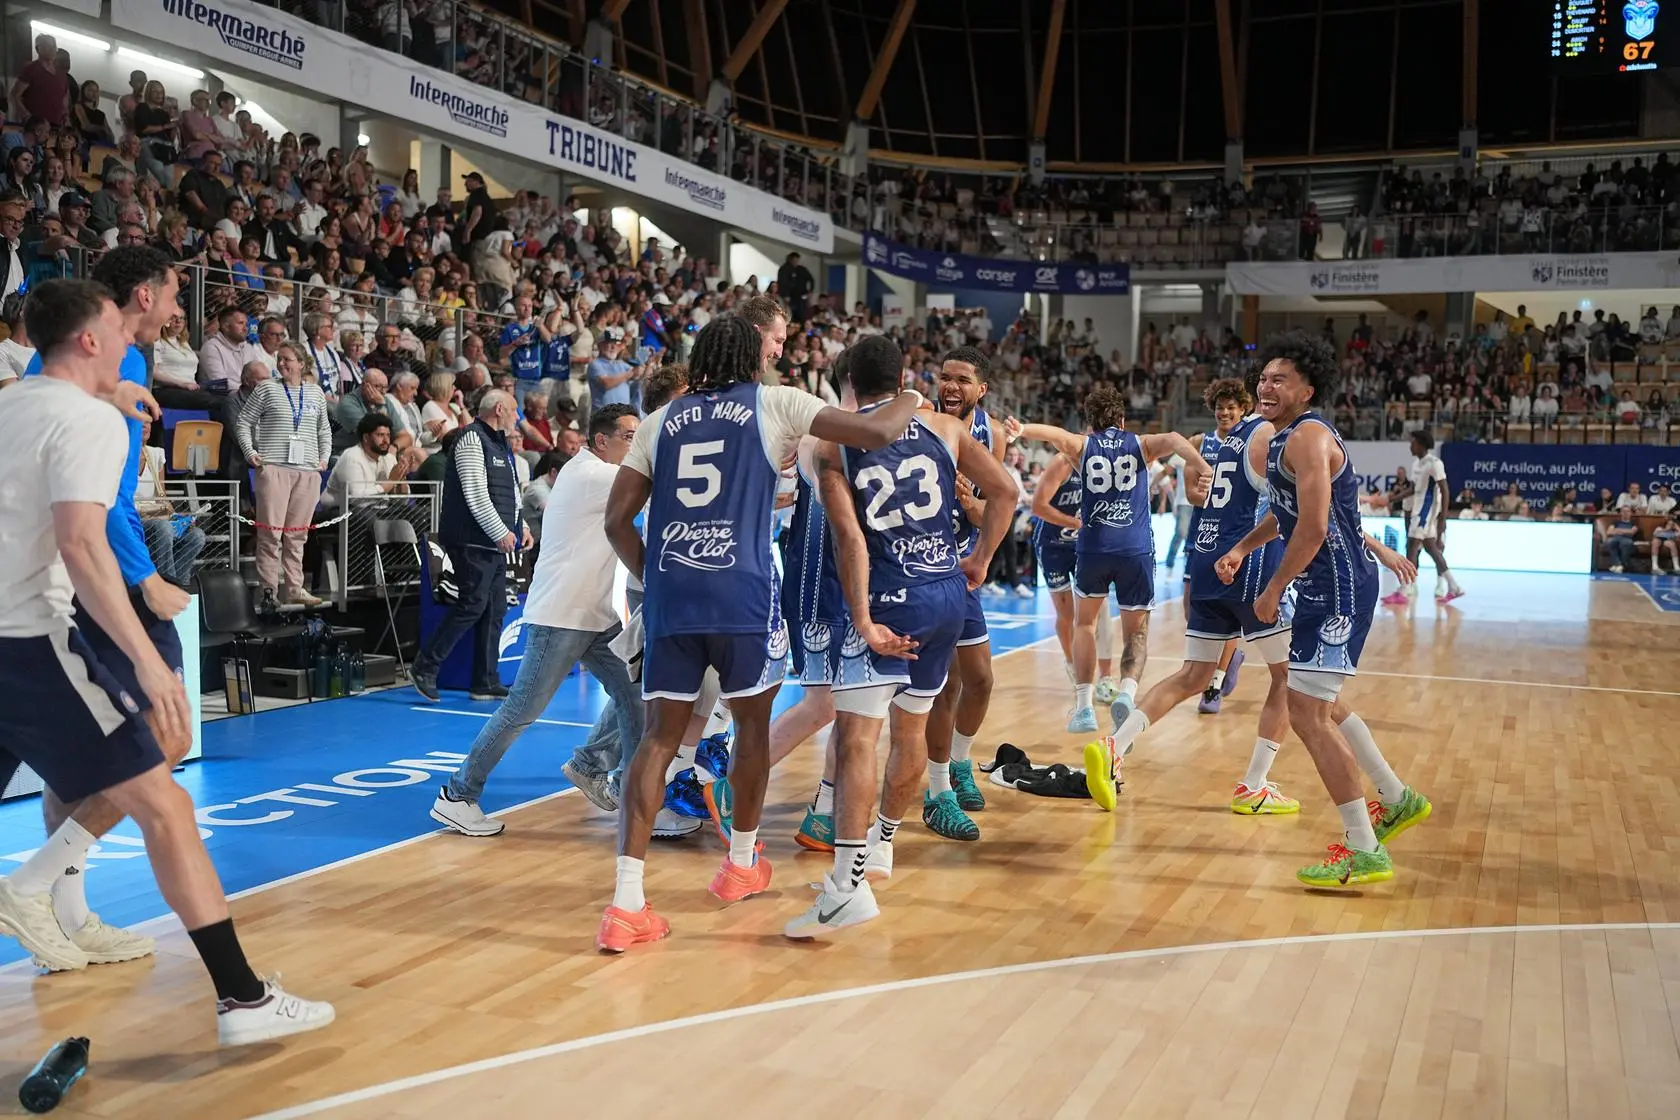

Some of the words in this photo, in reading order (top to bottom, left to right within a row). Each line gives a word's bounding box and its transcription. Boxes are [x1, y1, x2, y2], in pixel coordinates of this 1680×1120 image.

[1623, 41, 1655, 60] 67
[545, 119, 637, 183] TRIBUNE
[665, 406, 702, 437] AFFO
[711, 401, 754, 426] MAMA
[676, 440, 725, 508] 5
[1086, 454, 1138, 494] 88
[1473, 461, 1498, 473] PKF
[1499, 461, 1547, 476] Arsilon,
[1549, 465, 1566, 475] au
[1568, 462, 1596, 476] plus
[1578, 480, 1596, 492] de
[855, 454, 942, 531] 23
[661, 521, 733, 556] Pierre
[688, 538, 737, 558] Clot
[1197, 530, 1219, 544] Clot
